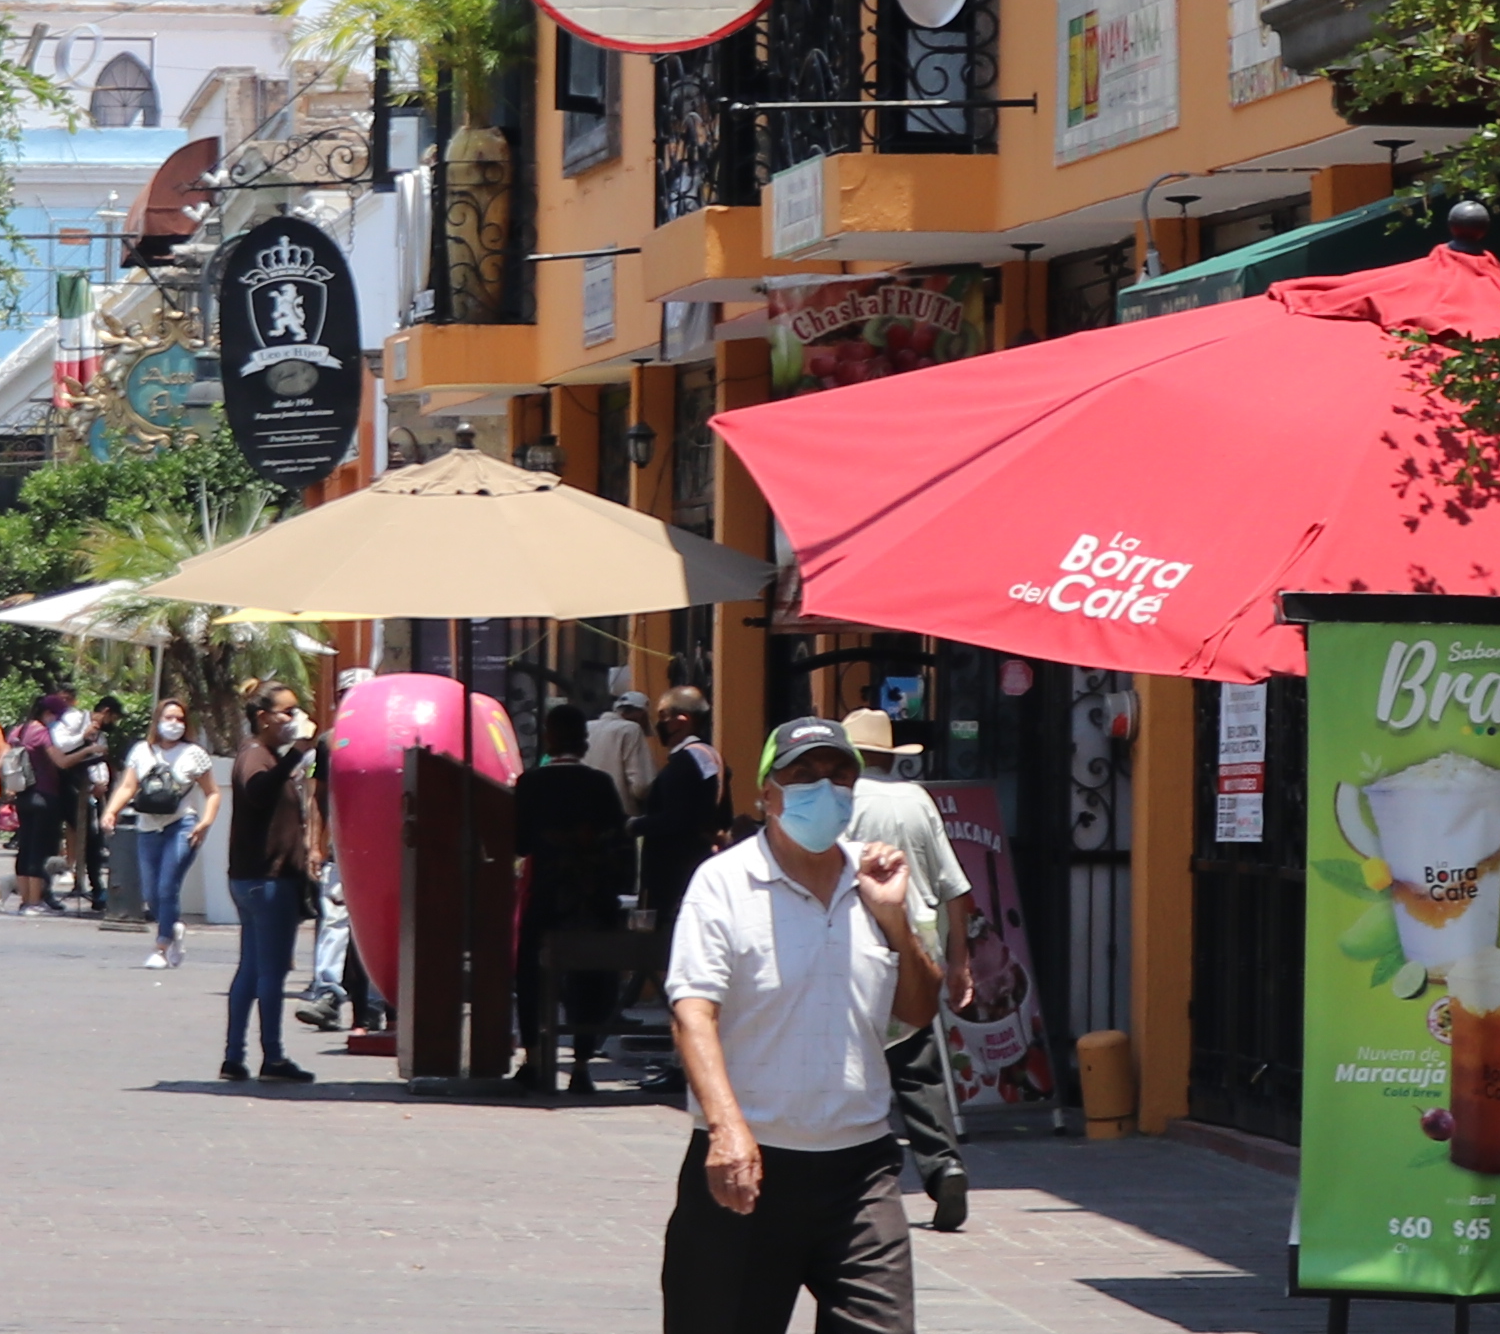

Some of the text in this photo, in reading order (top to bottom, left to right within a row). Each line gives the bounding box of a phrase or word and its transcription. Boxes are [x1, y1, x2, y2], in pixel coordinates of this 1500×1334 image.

[292, 347, 323, 359] Hijos
[1109, 531, 1142, 551] La
[1059, 534, 1194, 589] Borra
[1008, 574, 1170, 625] del Café
[937, 795, 958, 814] LA
[944, 821, 1001, 853] OACANA
[1424, 866, 1477, 883] Borra
[1356, 1046, 1441, 1063] Nuvem de
[1335, 1060, 1447, 1086] Maracujá
[1383, 1087, 1441, 1098] Cold brew
[1389, 1216, 1432, 1239] $60
[1453, 1218, 1491, 1240] $65
